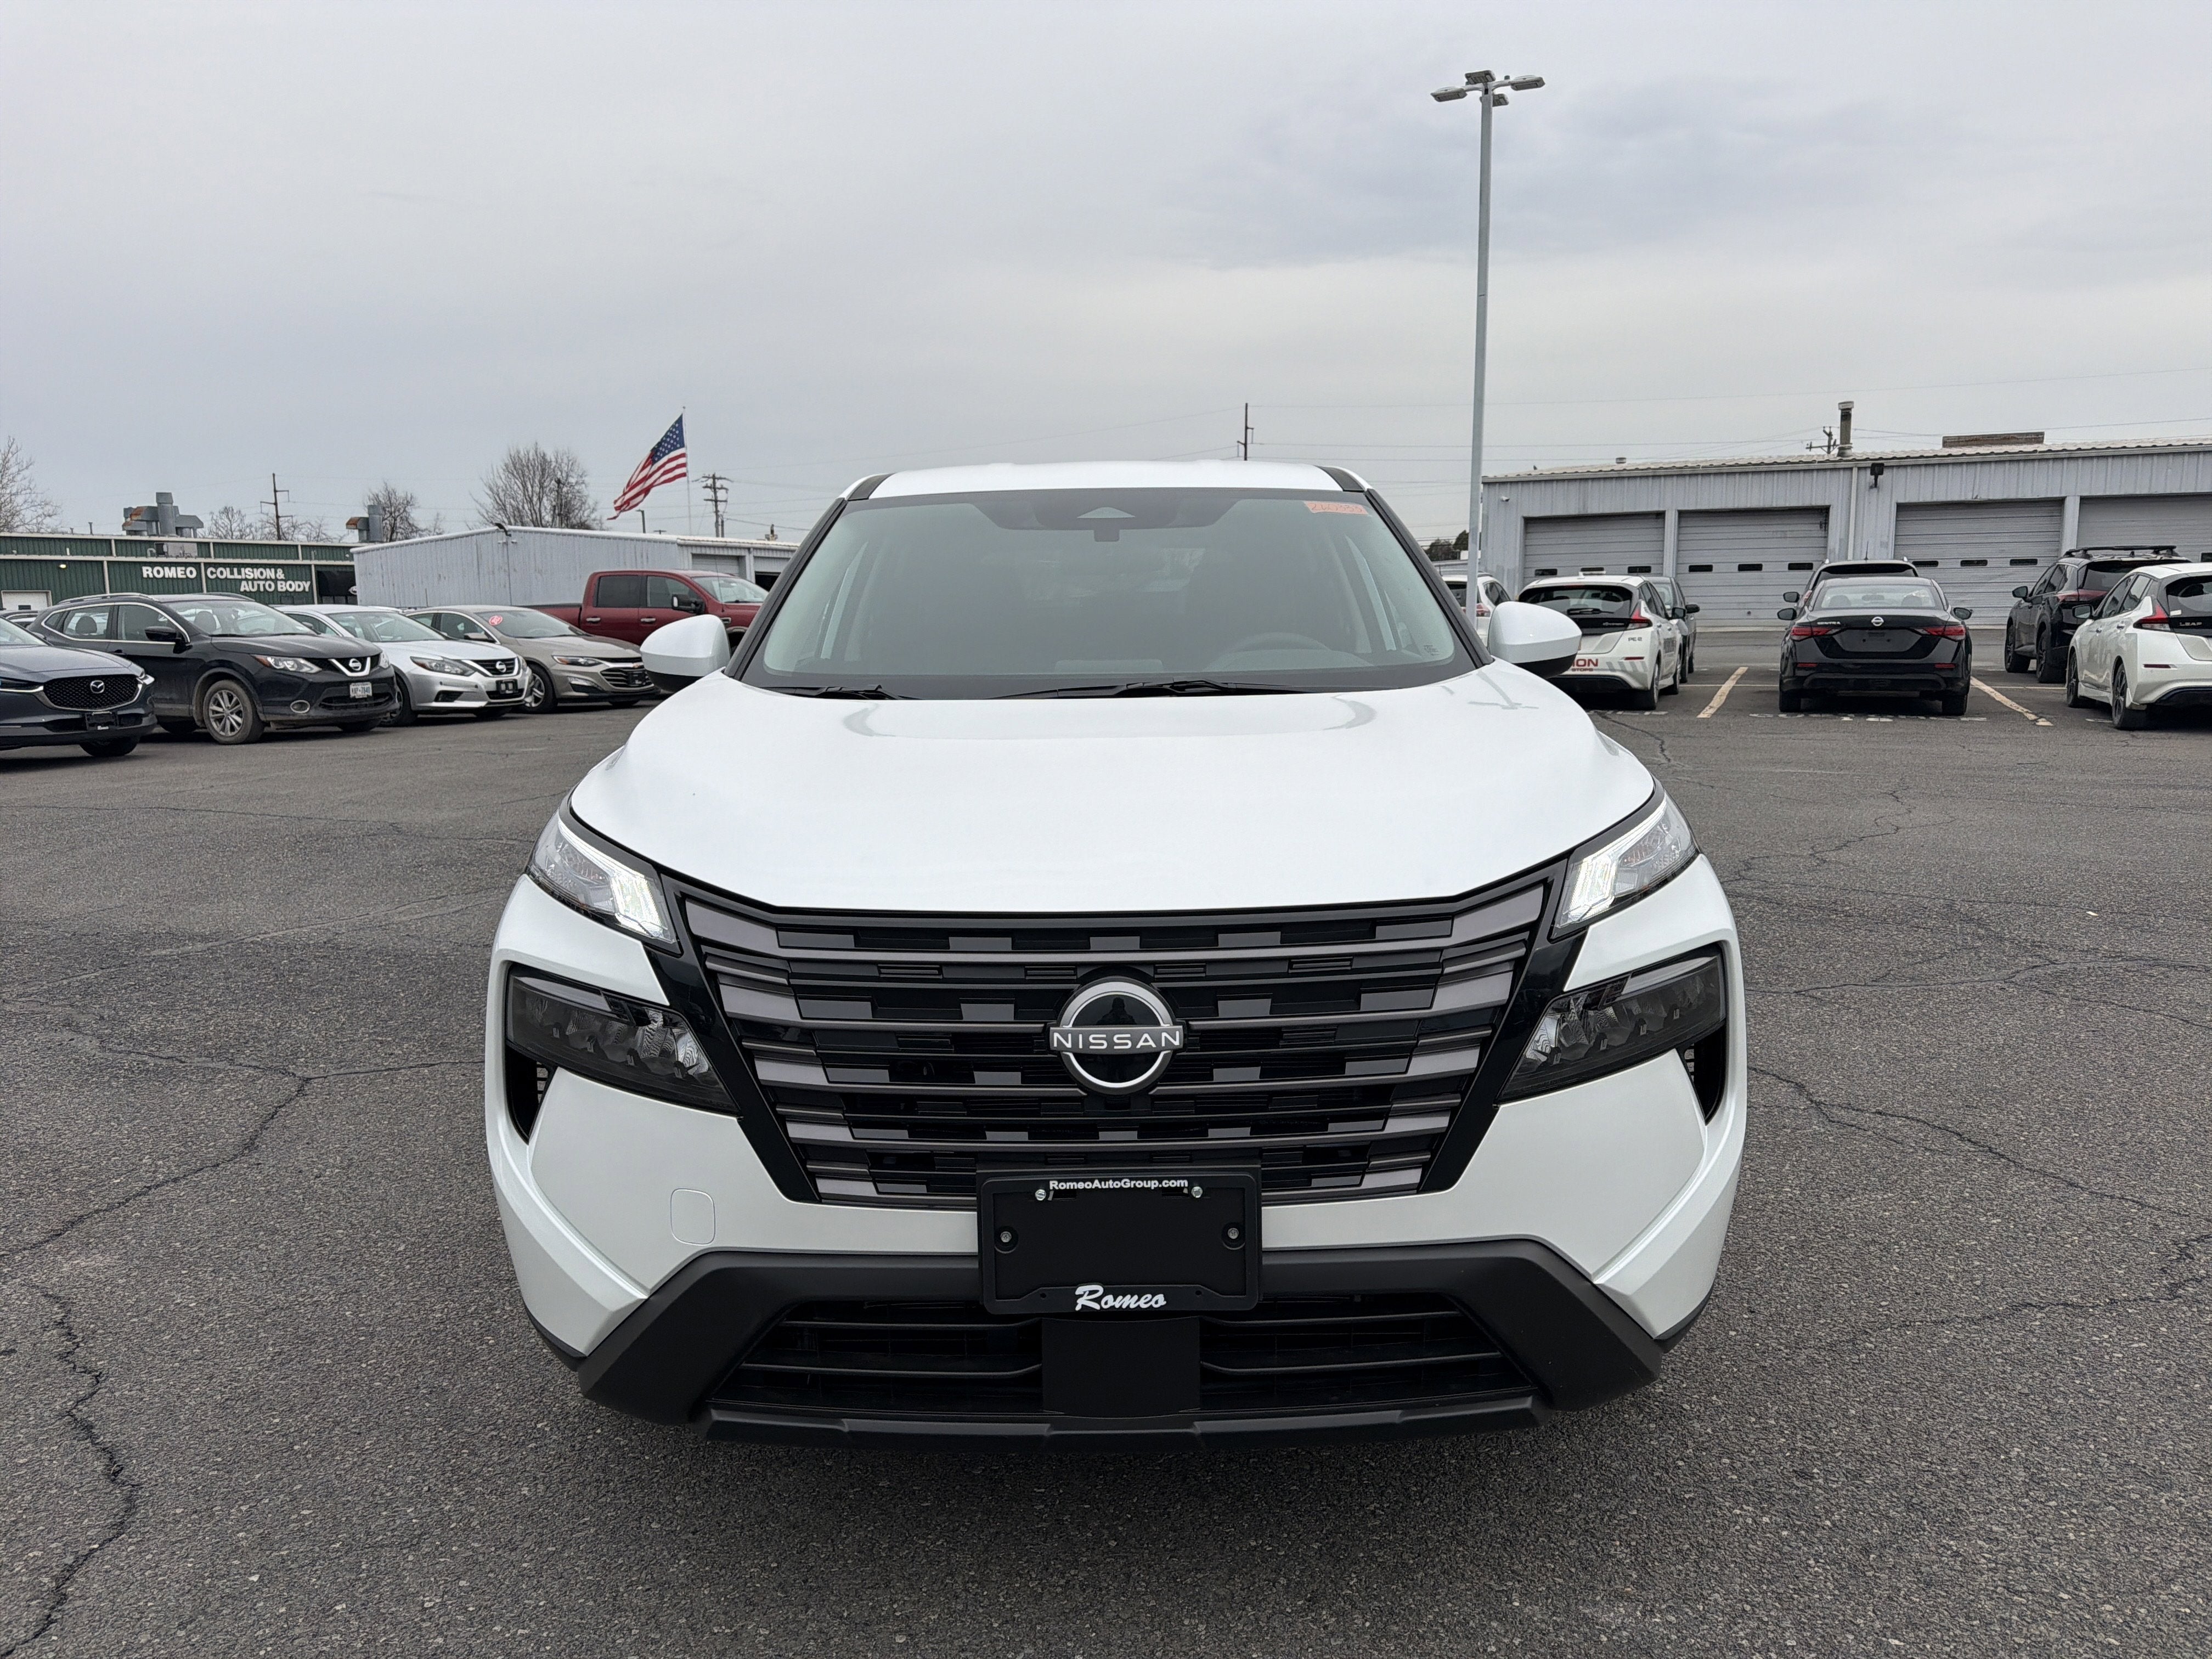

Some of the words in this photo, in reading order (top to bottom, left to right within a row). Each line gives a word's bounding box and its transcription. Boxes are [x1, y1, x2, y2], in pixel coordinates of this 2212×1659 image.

[142, 566, 197, 579] ROMEO
[206, 567, 275, 579] COLLISION
[240, 580, 275, 592] AUTO
[277, 581, 311, 592] BODY
[1053, 1030, 1180, 1049] NISSAN
[1049, 1178, 1188, 1190] RomeoAutoGroup.com
[1075, 1284, 1167, 1311] Romeo
